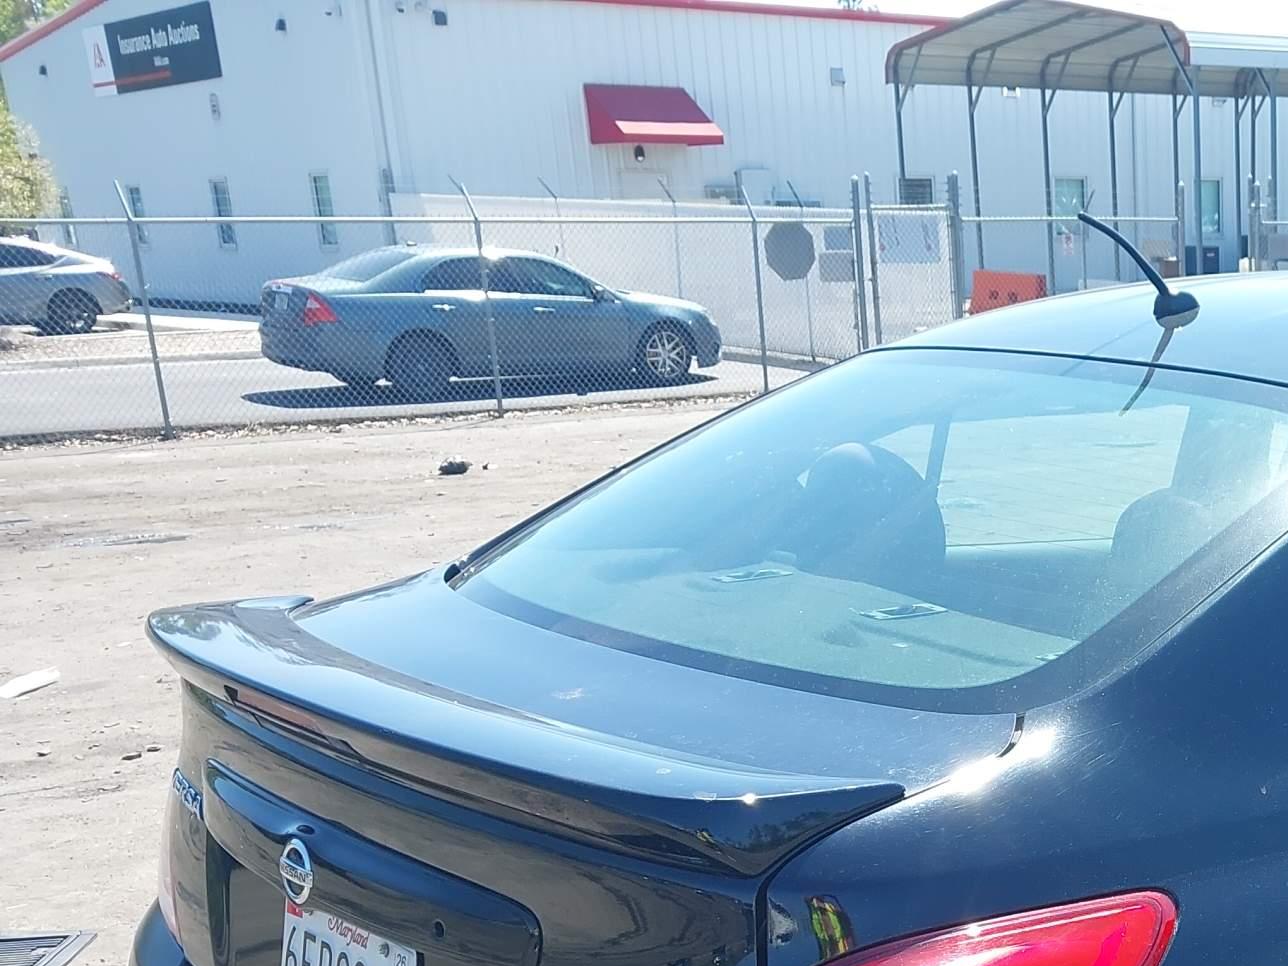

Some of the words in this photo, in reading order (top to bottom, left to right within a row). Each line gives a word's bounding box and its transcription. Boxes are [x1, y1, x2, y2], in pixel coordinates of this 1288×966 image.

[117, 34, 152, 55] Insurance
[151, 27, 168, 49] Auto
[167, 20, 200, 46] Auctions
[327, 917, 369, 950] Maryland
